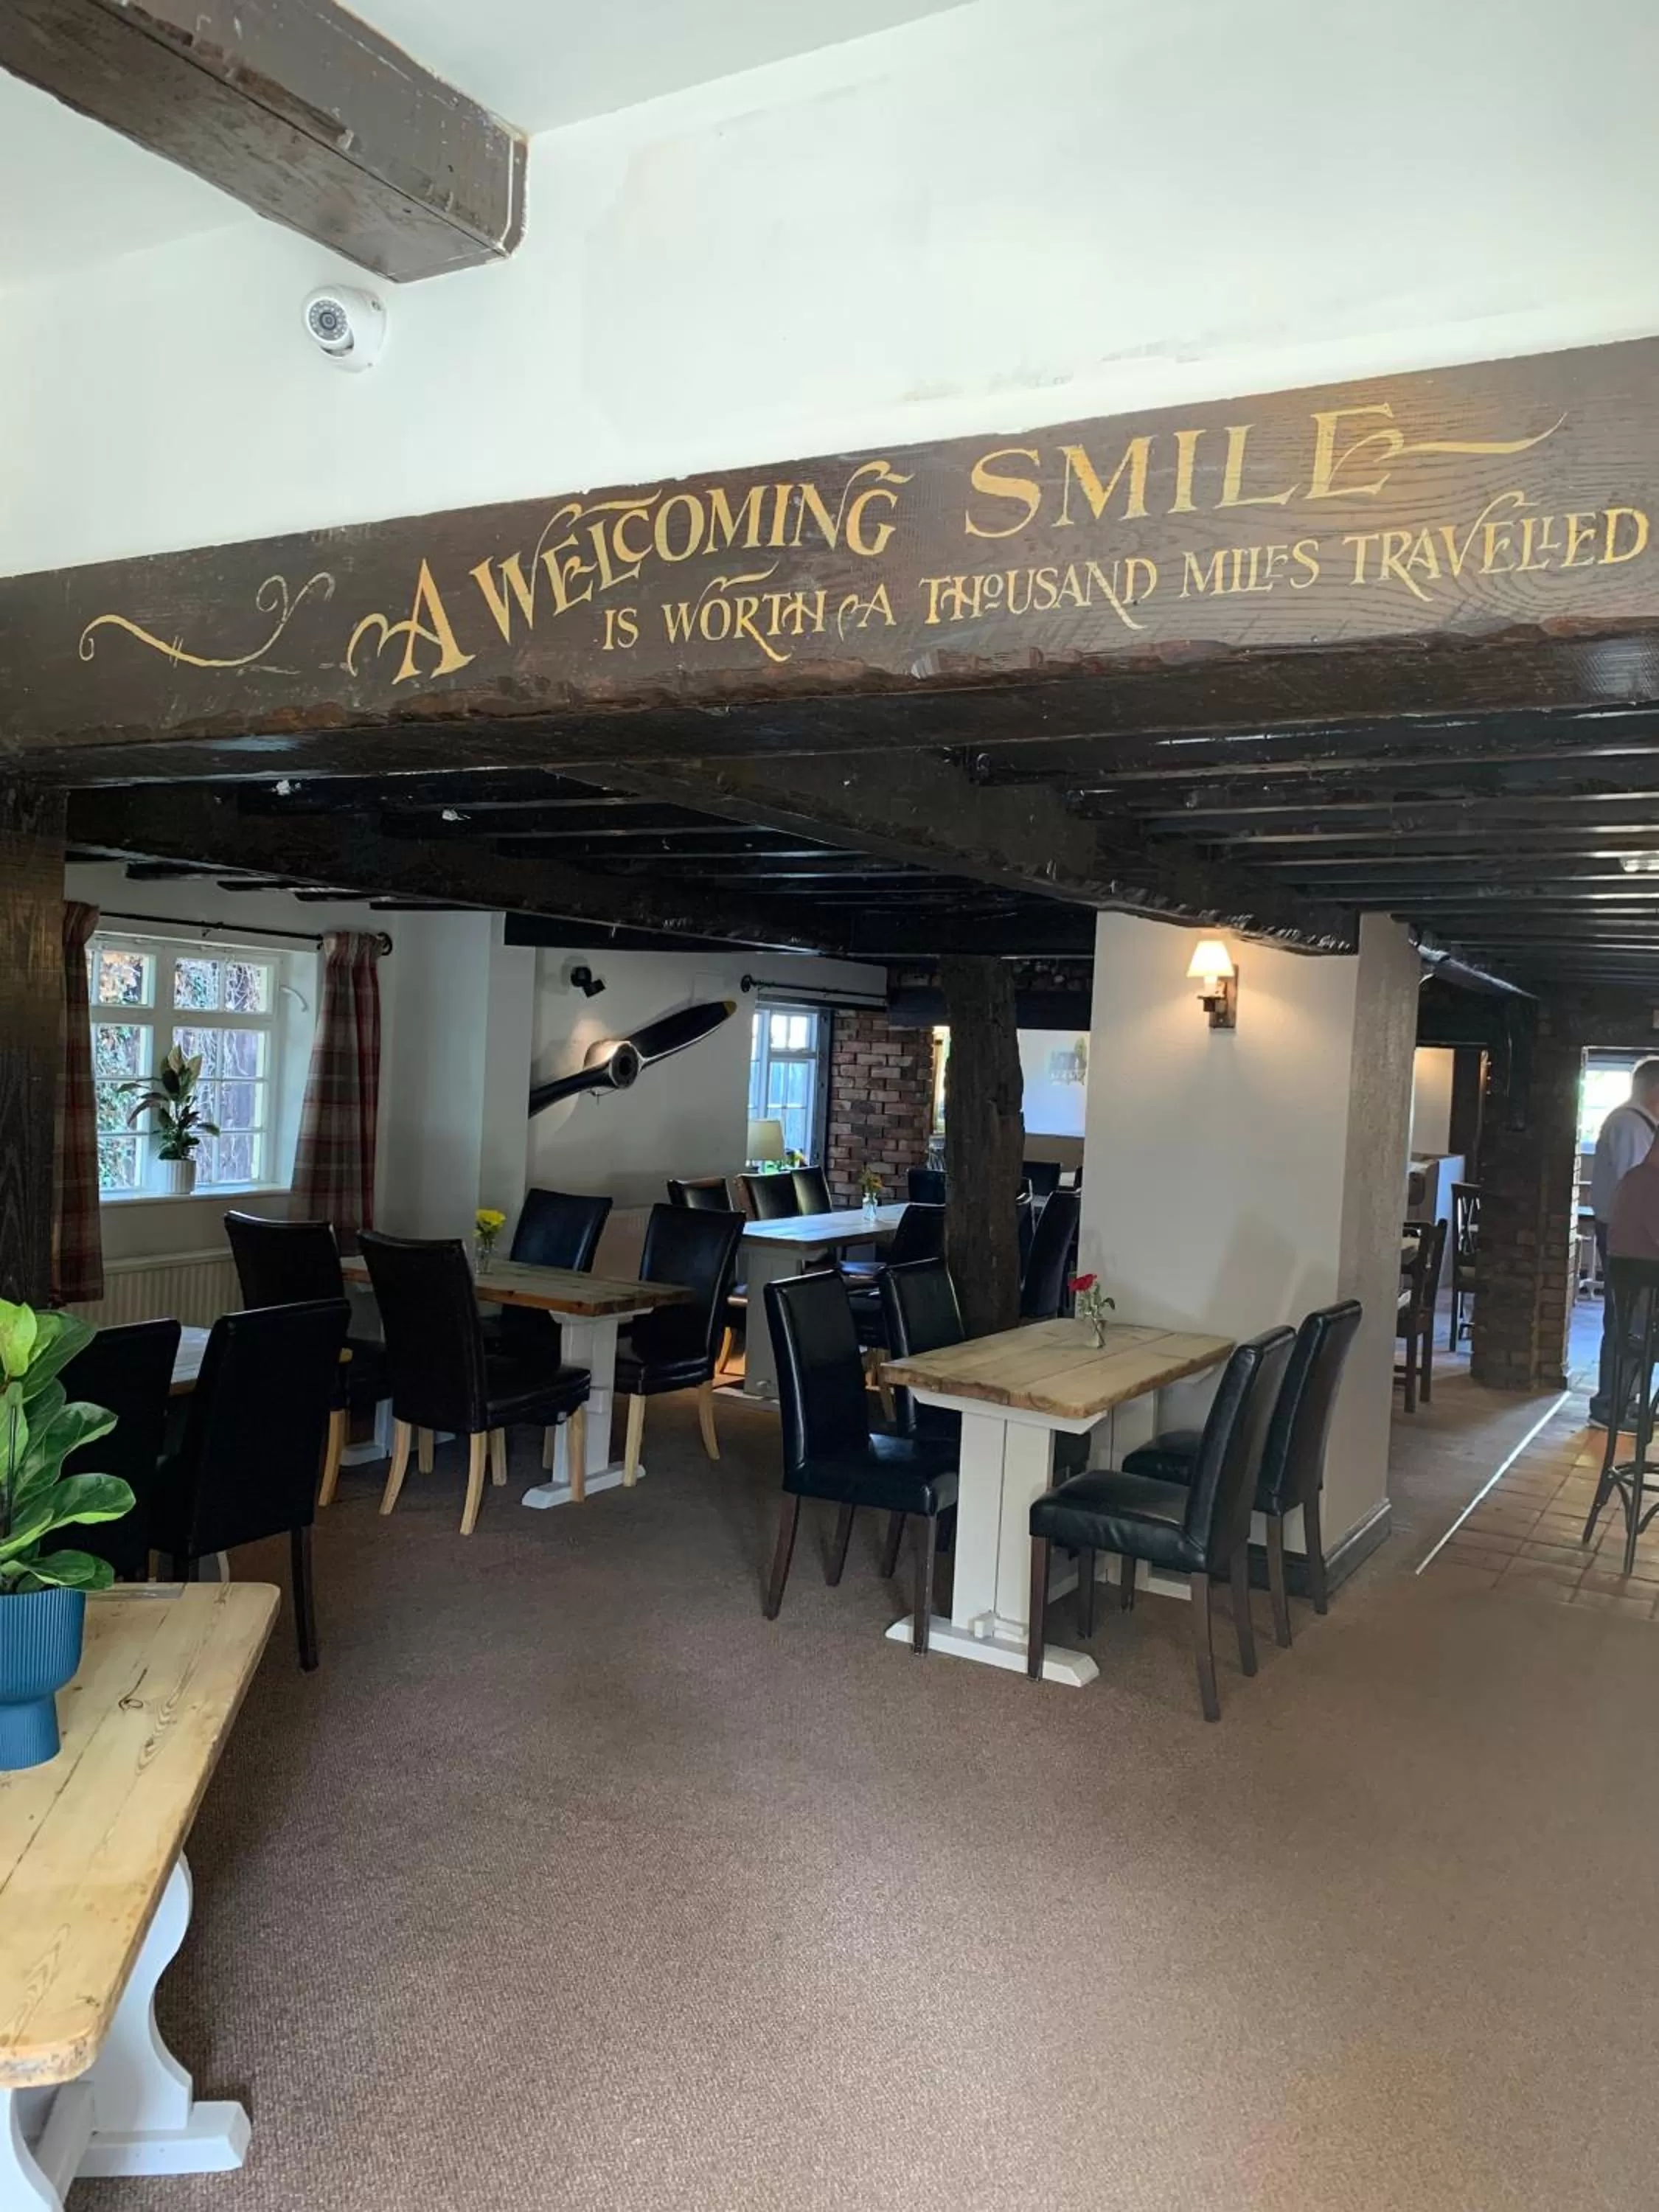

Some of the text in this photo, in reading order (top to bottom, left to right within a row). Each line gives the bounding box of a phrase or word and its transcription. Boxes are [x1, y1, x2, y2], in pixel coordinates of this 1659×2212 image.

[347, 402, 1568, 685] A WELCOMING SMILE
[602, 490, 1649, 661] IS WORTH A THOUSAND MILES TRAVELLED
